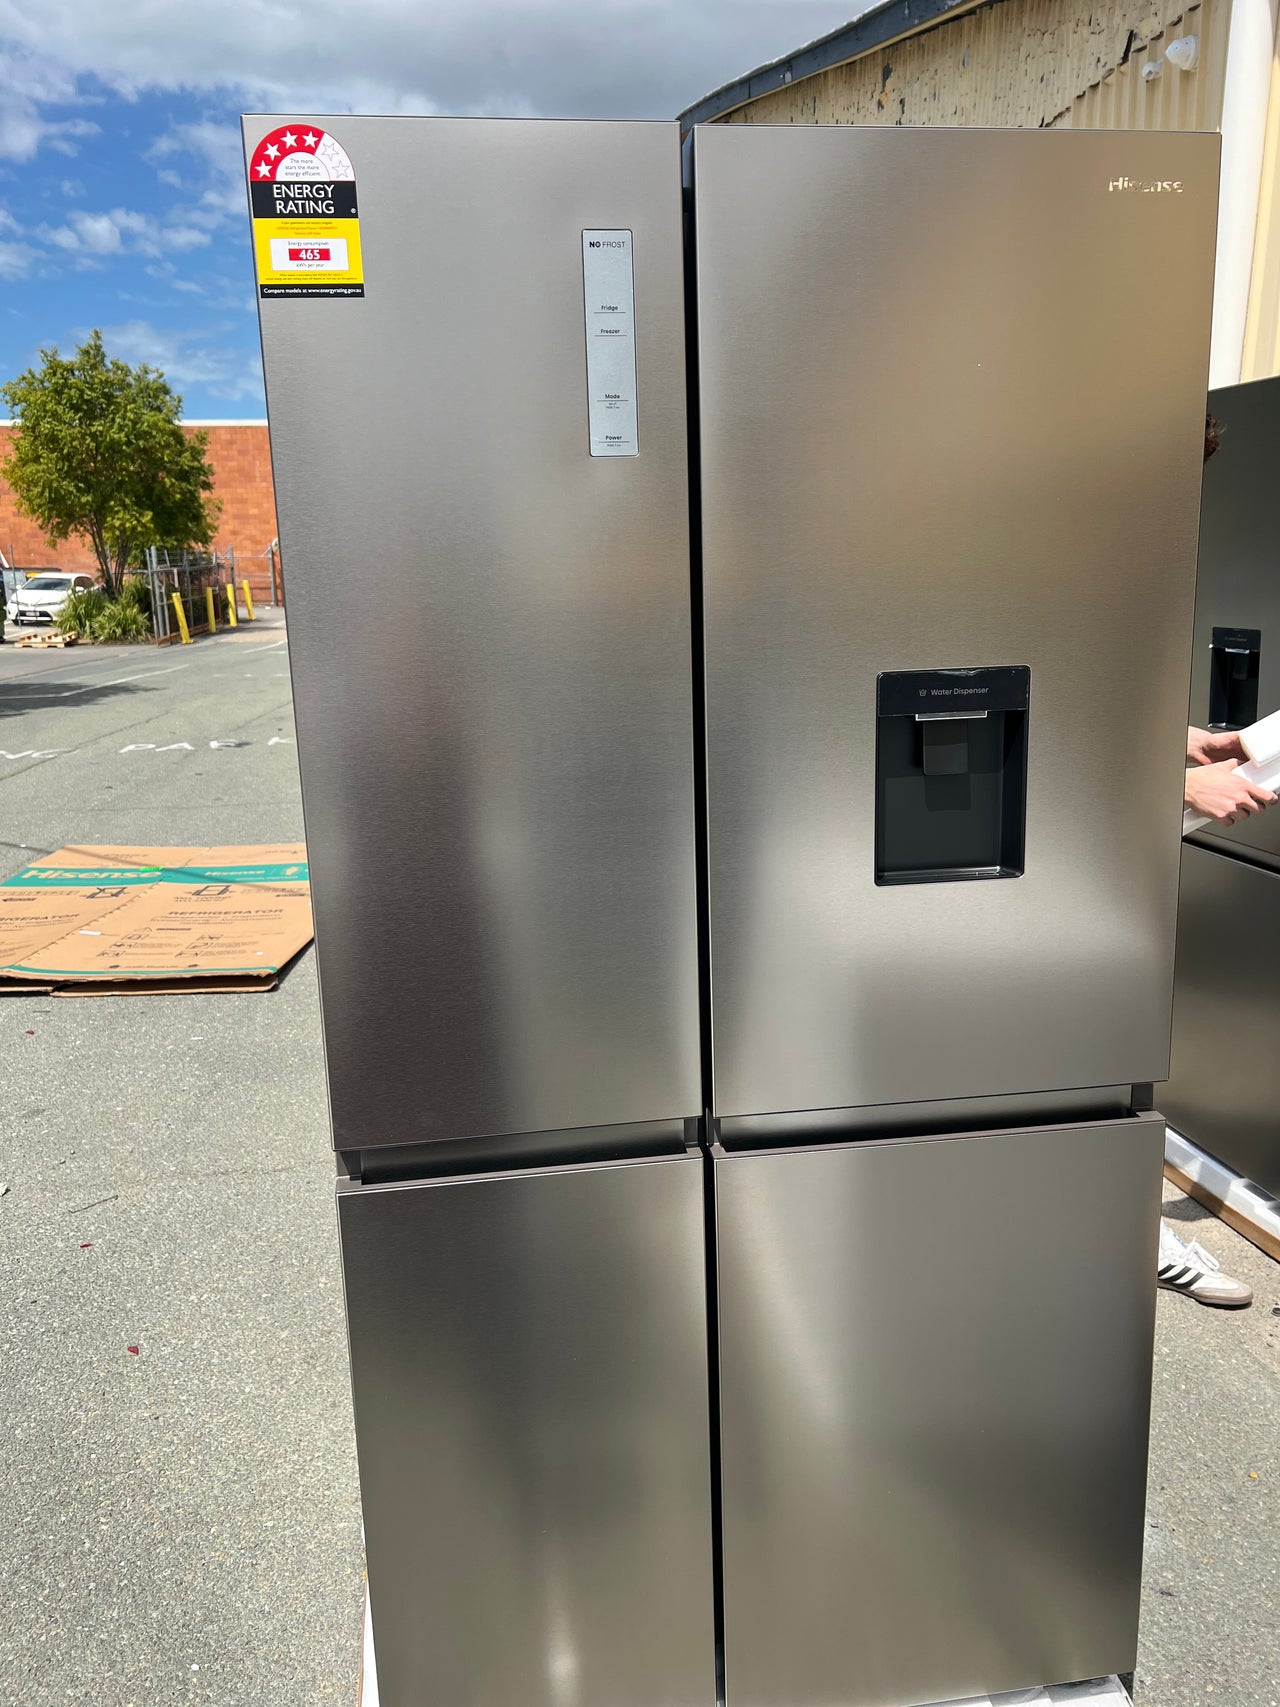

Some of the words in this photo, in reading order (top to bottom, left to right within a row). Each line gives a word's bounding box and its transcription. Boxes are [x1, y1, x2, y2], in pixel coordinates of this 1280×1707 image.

[272, 184, 335, 198] ENERGY
[276, 200, 335, 214] RATING
[299, 249, 320, 260] 465
[953, 687, 989, 695] Dispenser
[21, 870, 162, 879] Hisense
